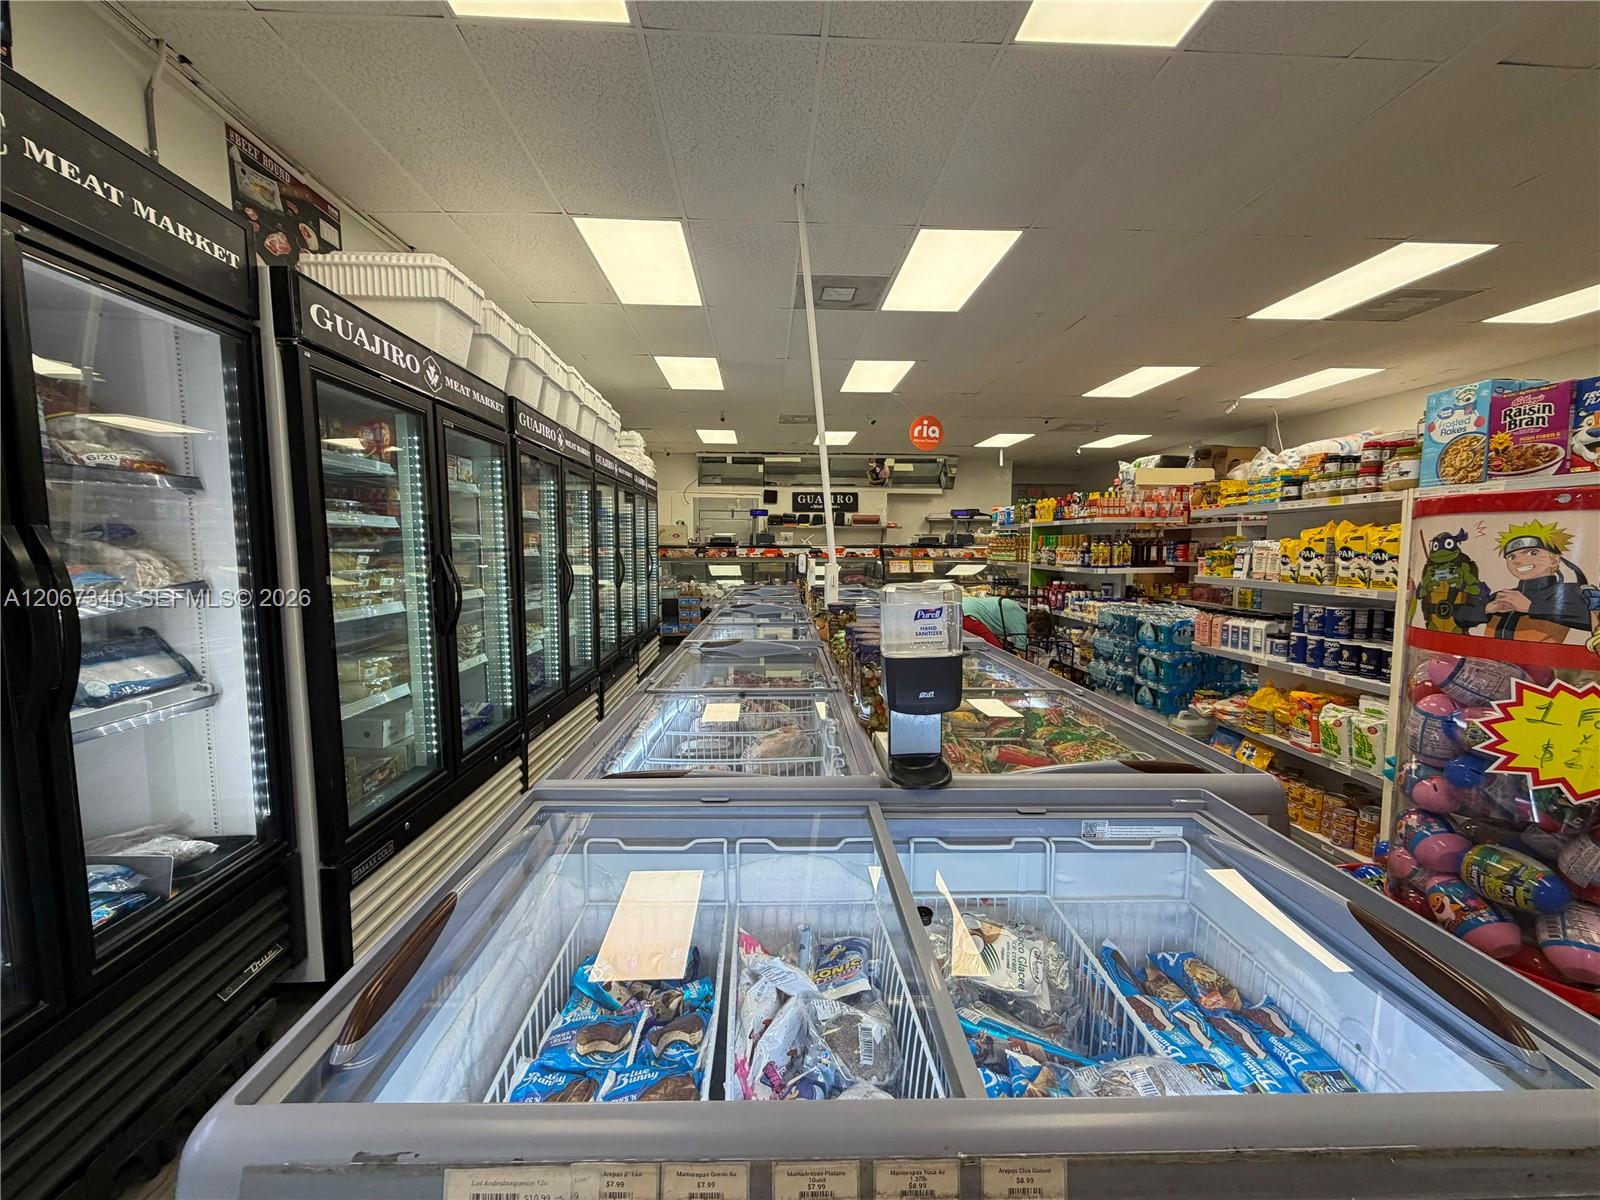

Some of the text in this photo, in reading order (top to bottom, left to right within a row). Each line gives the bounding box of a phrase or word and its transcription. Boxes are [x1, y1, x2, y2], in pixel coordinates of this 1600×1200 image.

[21, 135, 241, 270] MEAT MARKET
[309, 303, 505, 414] GUAJIRO MEAT MARKET
[1502, 403, 1554, 421] Raisin
[519, 412, 557, 441] GUAJIRO
[913, 419, 940, 438] ria
[1439, 416, 1471, 429] Frosted
[1440, 426, 1467, 436] Flakes
[1507, 415, 1547, 431] Bran
[797, 494, 853, 504] GUAIRO
[916, 609, 941, 620] Purell
[357, 842, 394, 877] MAXX COLD
[1018, 956, 1027, 991] Glacee
[998, 1167, 1018, 1175] Arepas
